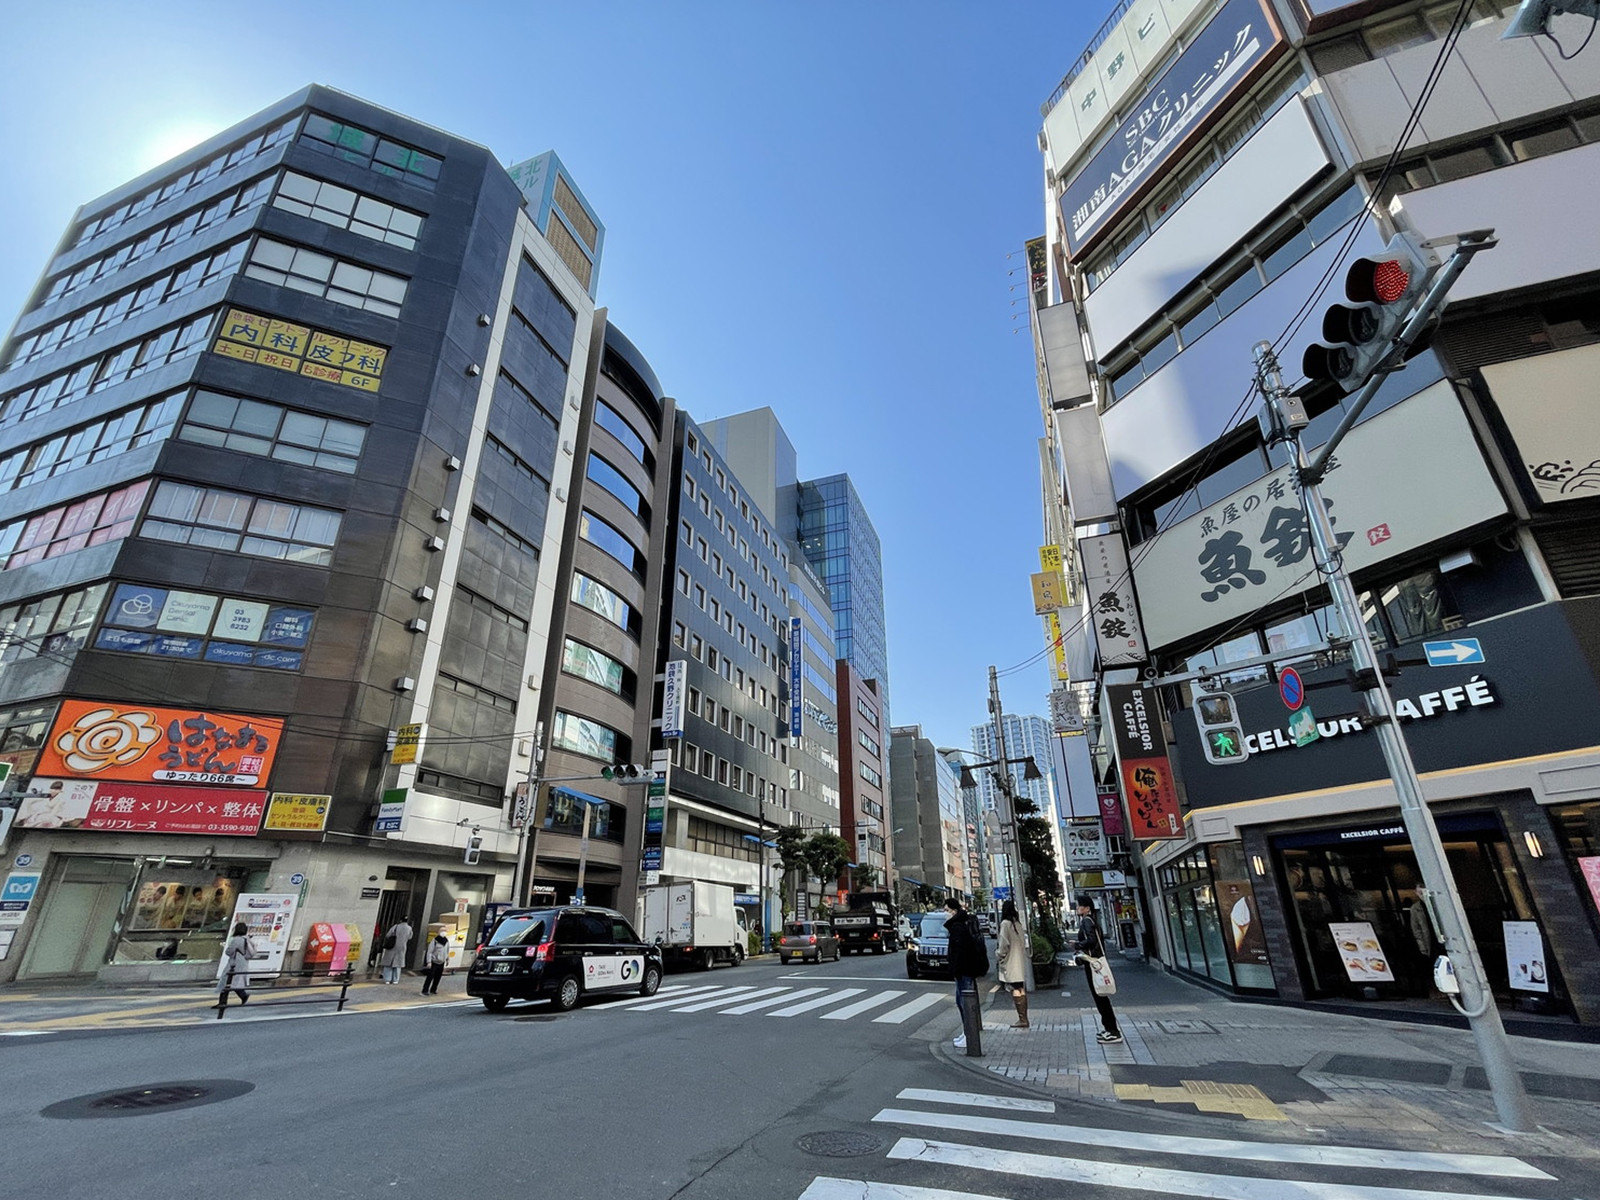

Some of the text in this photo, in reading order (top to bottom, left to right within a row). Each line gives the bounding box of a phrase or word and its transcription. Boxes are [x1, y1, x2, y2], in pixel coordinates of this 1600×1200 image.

[1072, 24, 1251, 229] 湘南AGAクリニック
[1125, 88, 1168, 142] SBC
[228, 323, 381, 374] 内科 皮フ科
[231, 311, 386, 358] 池袋セントラルクリニック
[351, 376, 371, 387] 6F
[234, 608, 245, 616] 03
[1098, 592, 1131, 639] 魚錠
[167, 713, 270, 754] はなまる
[1123, 702, 1140, 739] CAFFÉ
[1131, 689, 1153, 750] EXCELSIOR
[159, 744, 237, 773] うどん
[207, 823, 258, 832] 03-3590-9301
[1340, 829, 1379, 839] EXCELSIOR
